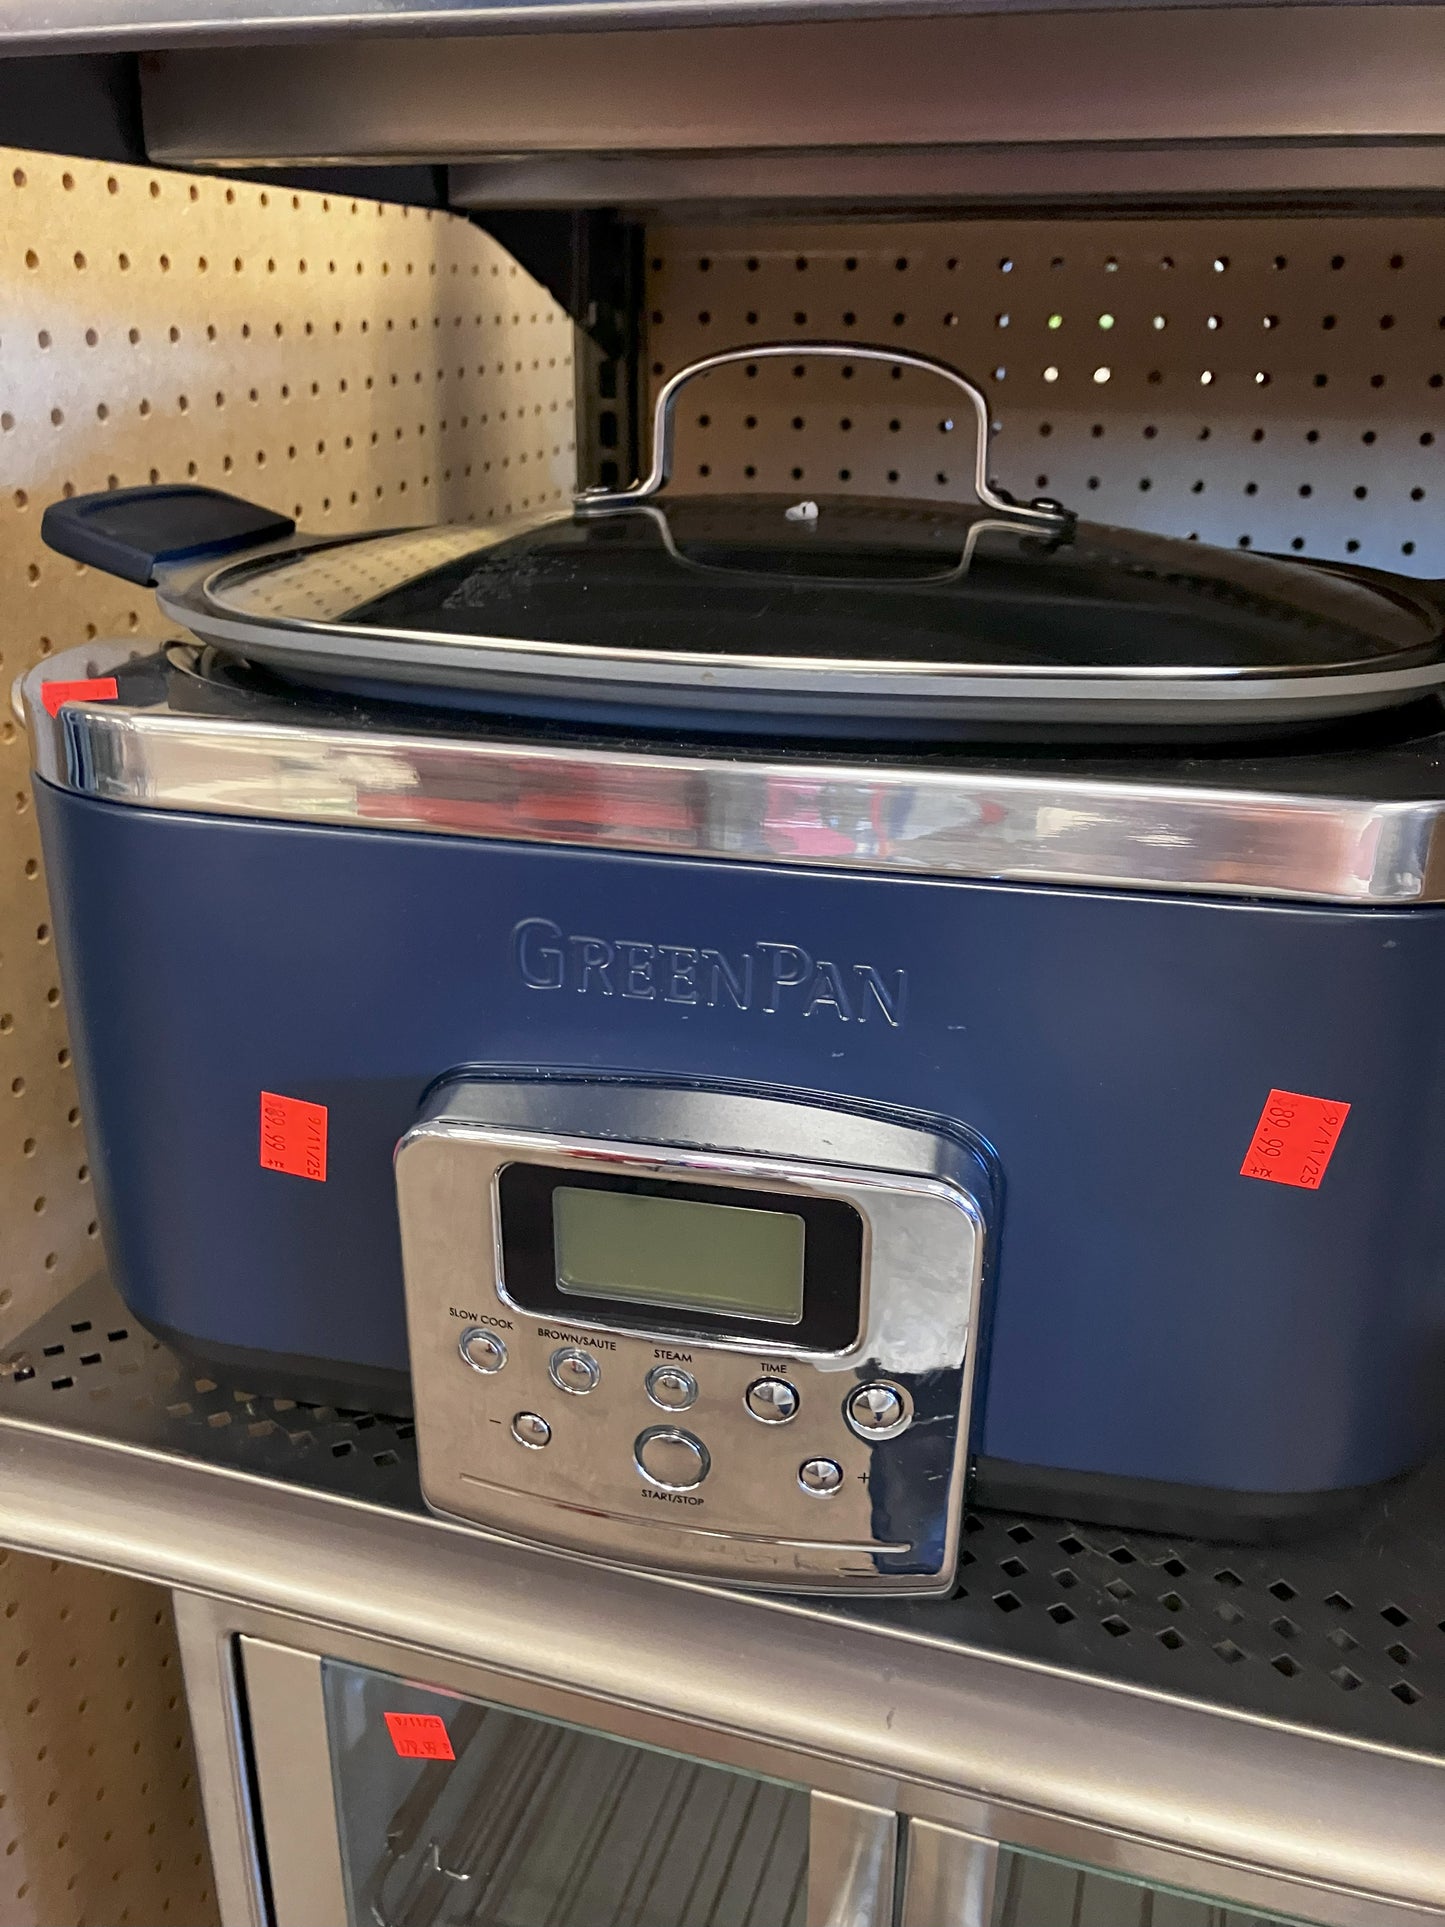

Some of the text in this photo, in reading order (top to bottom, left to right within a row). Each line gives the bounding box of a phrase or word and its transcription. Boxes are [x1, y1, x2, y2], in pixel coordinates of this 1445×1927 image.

[1256, 1107, 1295, 1157] 89.99
[306, 1116, 322, 1177] 9/11/25
[1300, 1116, 1338, 1185] 9/11/25
[449, 1306, 514, 1331] SLOW COOK
[537, 1327, 617, 1352] BROWN/SAUTE
[653, 1349, 693, 1363] STEAM
[760, 1362, 788, 1374] TIME
[641, 1488, 705, 1506] START/STOP
